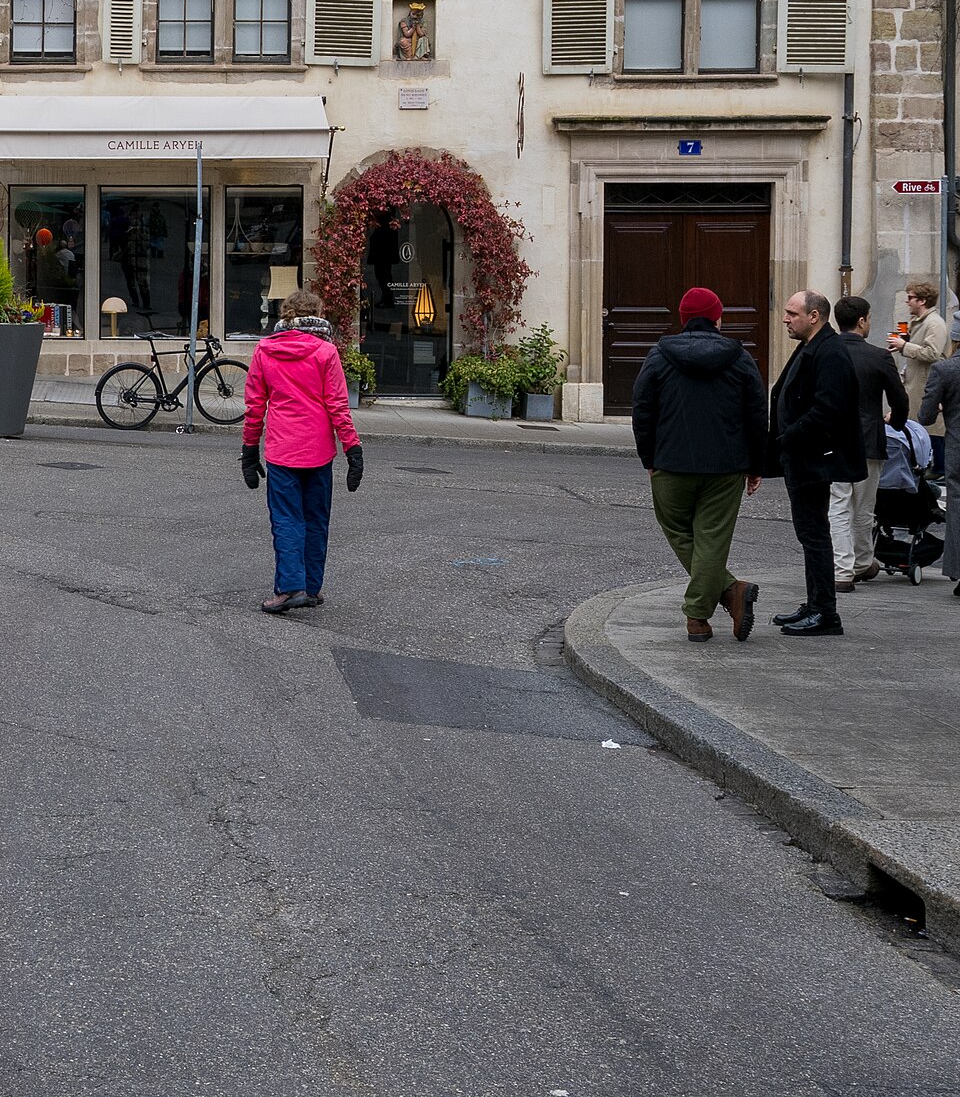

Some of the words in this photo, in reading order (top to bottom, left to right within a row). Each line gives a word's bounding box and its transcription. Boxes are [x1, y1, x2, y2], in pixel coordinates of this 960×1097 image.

[107, 140, 160, 150] CAMILLE
[686, 142, 695, 153] 7
[902, 182, 922, 192] Rive
